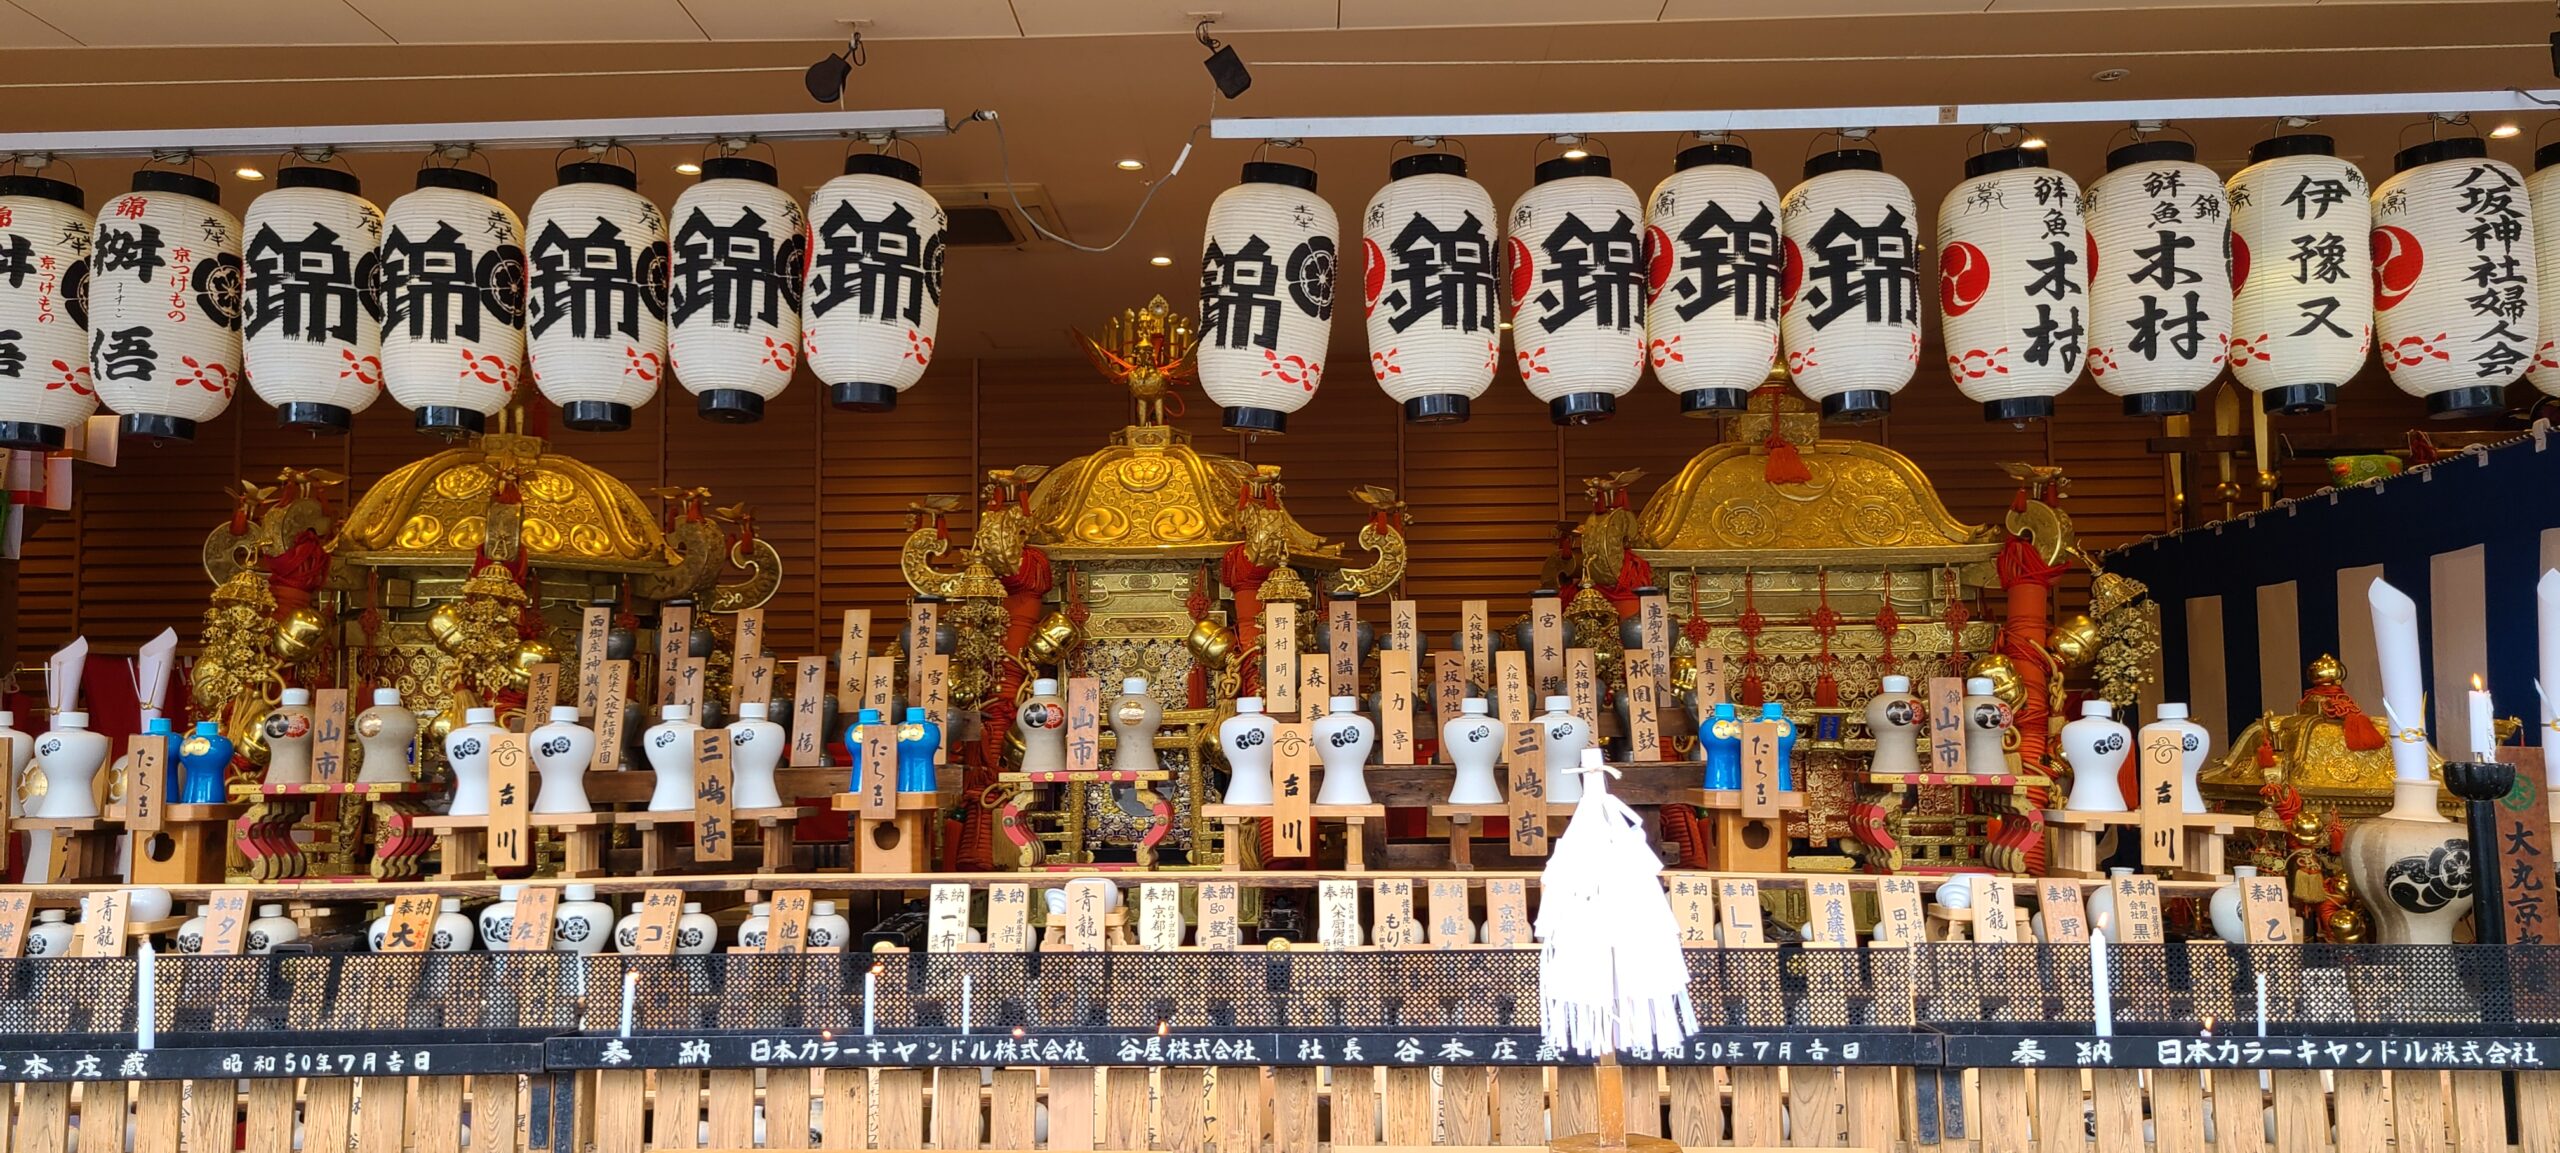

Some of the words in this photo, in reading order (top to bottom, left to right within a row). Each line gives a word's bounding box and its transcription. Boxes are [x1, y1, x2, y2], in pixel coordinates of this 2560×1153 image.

[117, 196, 148, 220] 錦
[38, 255, 57, 324] 京つけもの
[167, 247, 193, 323] 京つけもの
[244, 220, 358, 346] 錦
[381, 220, 481, 348] 錦
[529, 214, 640, 342] 錦
[672, 205, 779, 330] 錦
[810, 200, 925, 328] 錦
[1382, 210, 1498, 334] 錦
[1533, 209, 1646, 334] 錦
[1671, 200, 1782, 323] 錦
[1803, 203, 1921, 331] 錦
[2281, 174, 2354, 339] 伊豫又
[2451, 163, 2529, 378] 八坂神社婦人会
[1200, 234, 1281, 351] 錦
[739, 618, 757, 698] 裏千
[751, 666, 767, 704] 中
[846, 623, 864, 693] 表千家
[1274, 616, 1288, 697] 野村明義
[1335, 611, 1355, 697] 清々講社
[1539, 613, 1559, 692] 宮本組
[1390, 669, 1407, 751] 一力亭
[1443, 658, 1462, 722] 八坂神社
[1629, 658, 1658, 752] 祇園太鼓
[315, 718, 342, 780] 山市
[1070, 706, 1095, 766] 山市
[1751, 735, 1771, 806] たち吉
[1935, 706, 1962, 769] 山市
[137, 747, 153, 818] たち吉
[698, 735, 727, 854] 三嶋亭
[870, 738, 888, 808] たち吉
[1513, 727, 1545, 848] 三嶋亭
[496, 782, 519, 861] 吉川
[1282, 772, 1304, 853] 吉川
[2153, 780, 2176, 862] 吉川
[397, 898, 432, 917] 奉納
[647, 893, 678, 907] 奉納
[775, 896, 806, 912] 奉納
[934, 888, 965, 904] 奉納
[992, 887, 1025, 904] 奉納
[1145, 886, 1176, 902] 奉納
[1202, 884, 1236, 901] 奉納
[1323, 884, 1355, 901] 奉納
[1378, 881, 1409, 897] 奉納
[1675, 881, 1708, 897] 奉納
[1722, 883, 1755, 897] 奉納
[1884, 878, 1916, 894] 奉納
[2047, 885, 2078, 903] 奉納
[2120, 879, 2156, 897] 奉納
[2250, 882, 2284, 903] 奉納
[96, 895, 118, 957] 青龍
[0, 1053, 149, 1079] 本庄蔵
